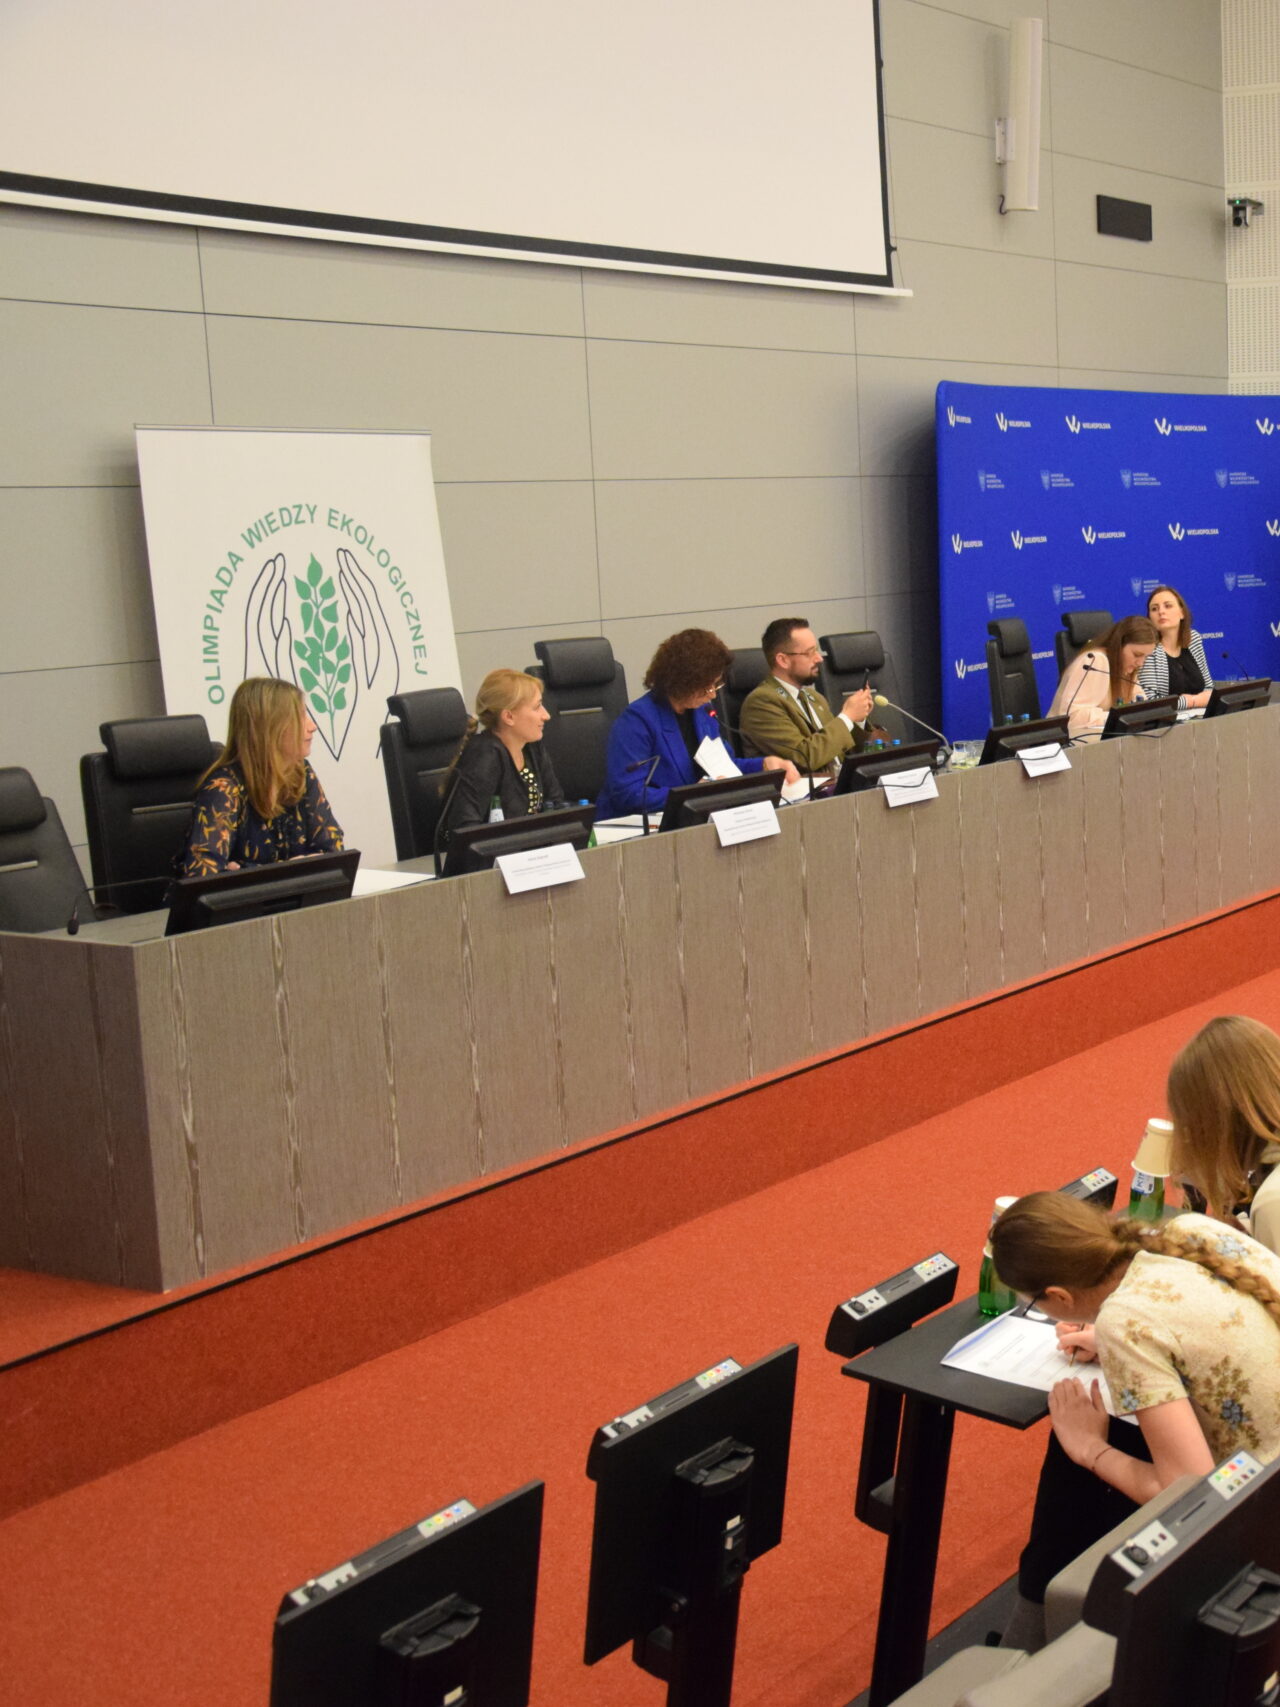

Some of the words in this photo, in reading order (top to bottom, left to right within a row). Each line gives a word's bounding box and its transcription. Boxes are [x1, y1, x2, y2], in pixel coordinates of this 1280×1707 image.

[202, 551, 244, 705] OLIMPIADA
[240, 503, 317, 549] WIEDZY
[327, 508, 428, 676] EKOLOGICZNEJ
